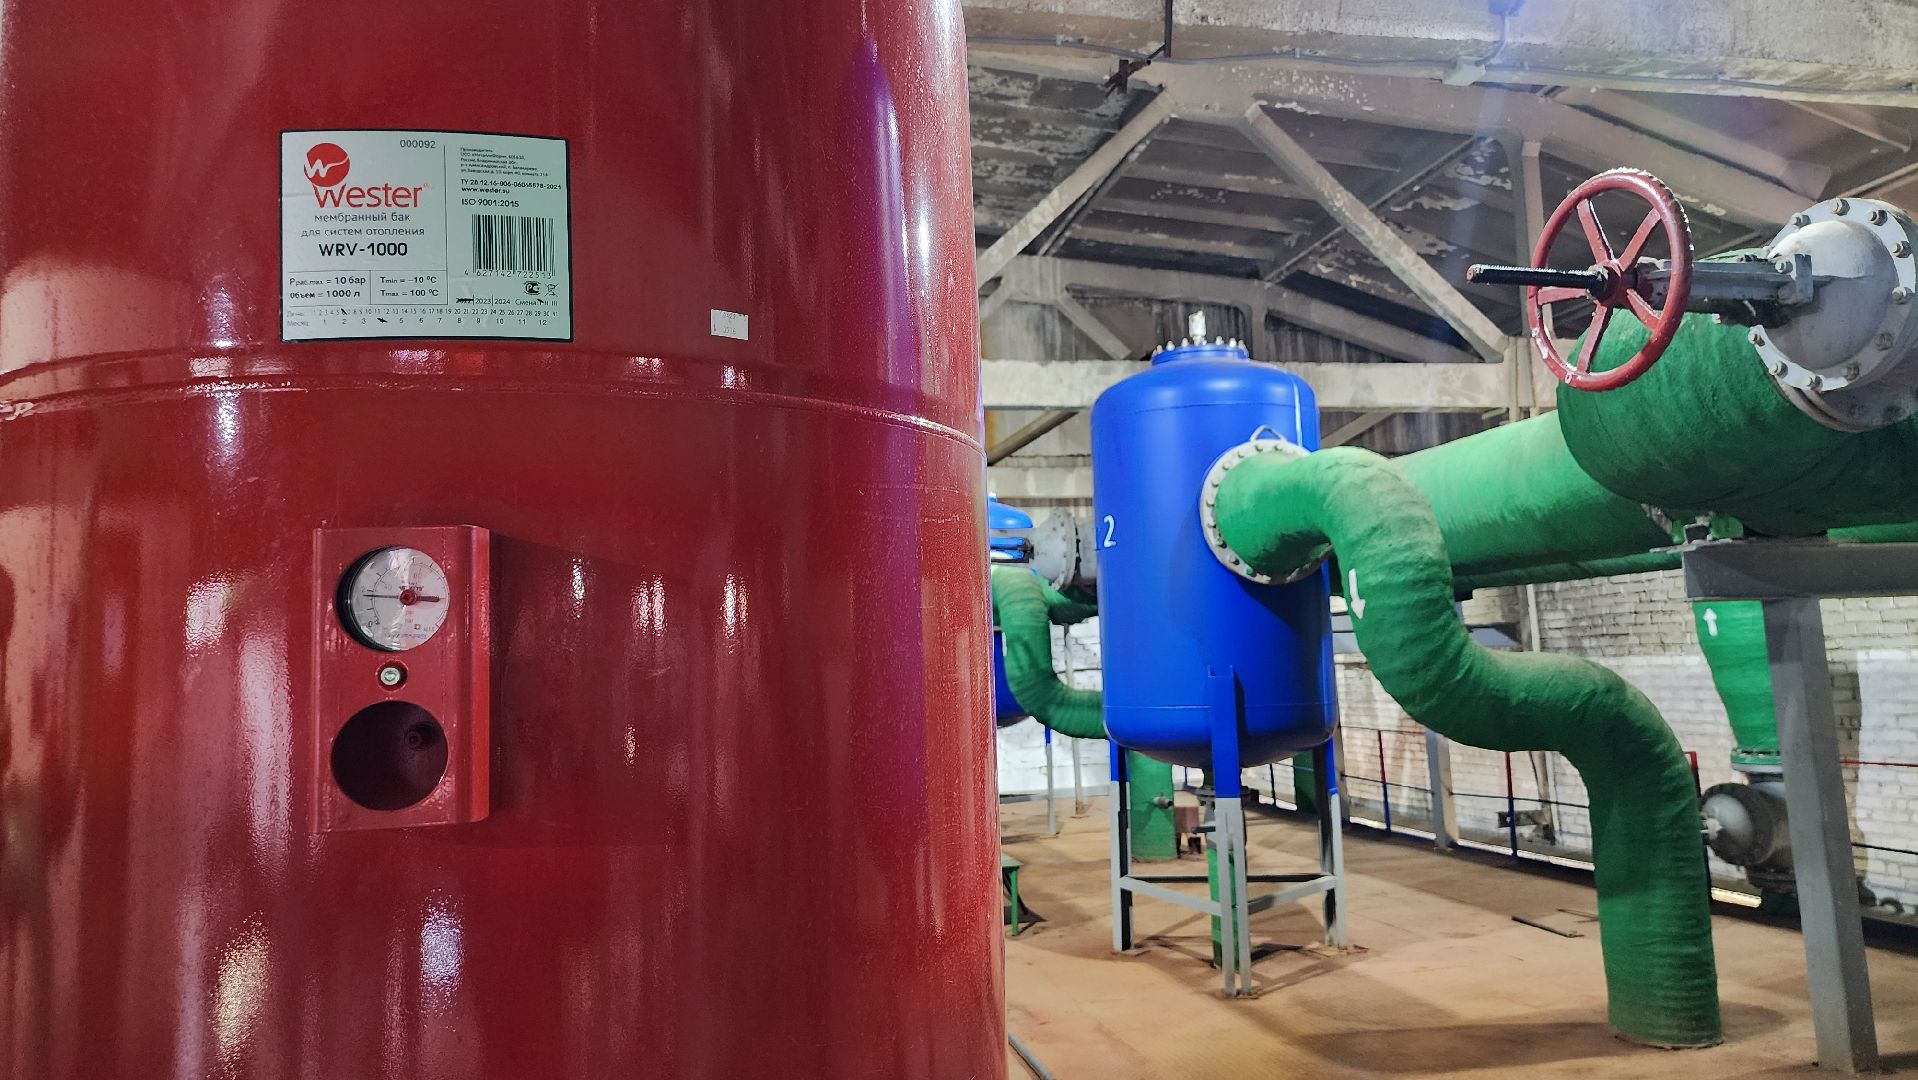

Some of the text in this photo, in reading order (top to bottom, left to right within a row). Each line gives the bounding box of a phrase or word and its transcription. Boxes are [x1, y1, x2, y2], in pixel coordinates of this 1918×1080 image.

[400, 140, 436, 148] 000092
[312, 182, 422, 208] Wester
[478, 198, 520, 208] 9001:2015
[314, 212, 411, 224] мембранный бак
[300, 227, 425, 238] для систем отопления
[318, 242, 408, 256] WRV-1000
[334, 276, 346, 284] 10
[348, 276, 366, 286] бар
[326, 290, 352, 298] 1000
[1104, 514, 1116, 548] 2
